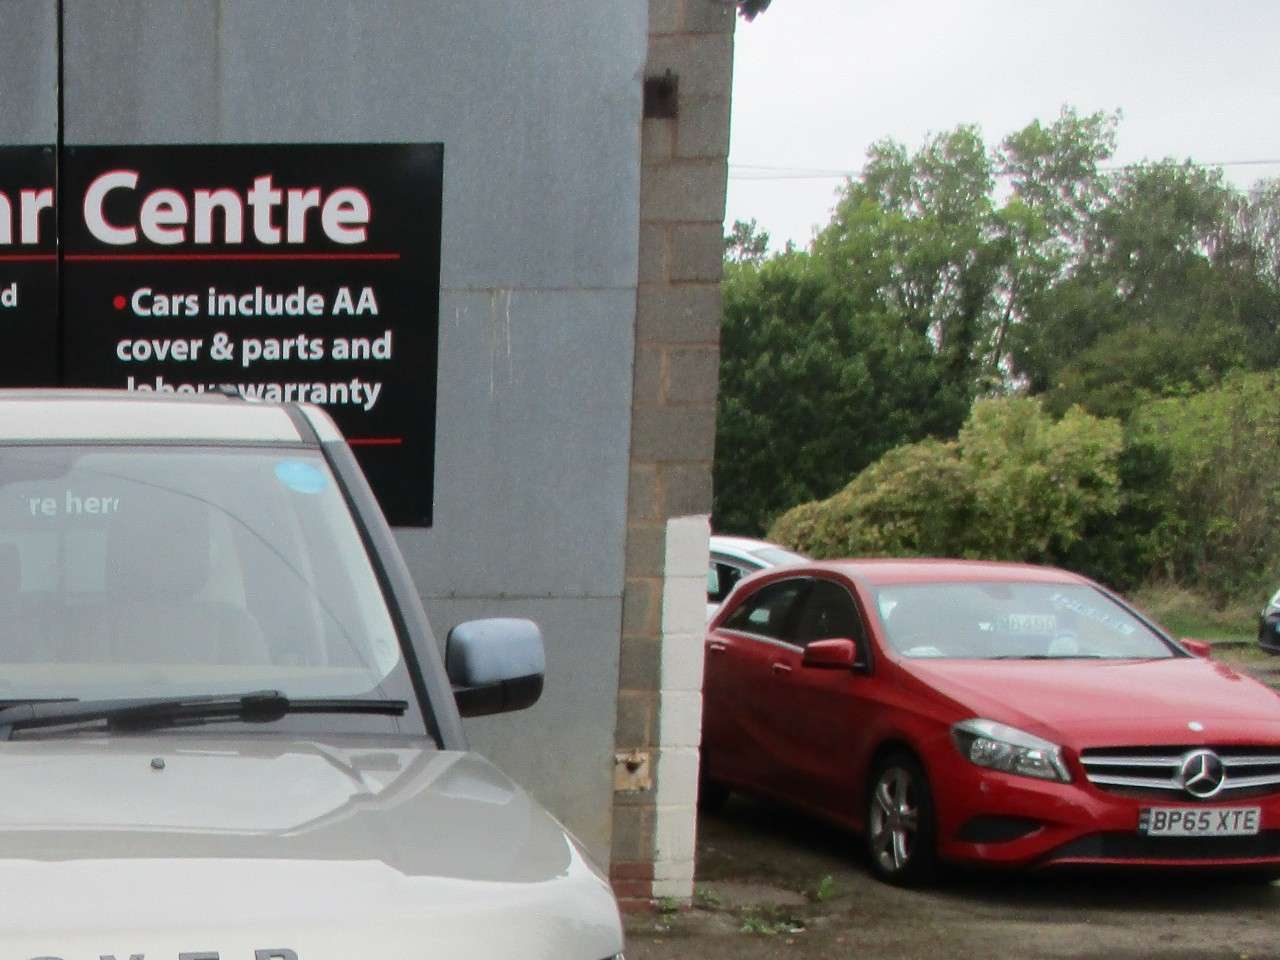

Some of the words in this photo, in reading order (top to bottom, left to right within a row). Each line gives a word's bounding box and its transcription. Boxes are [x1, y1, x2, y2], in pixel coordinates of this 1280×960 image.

[83, 170, 371, 245] Centre
[131, 287, 200, 317] Cars
[208, 285, 325, 316] include
[331, 286, 379, 316] AA
[116, 339, 203, 361] cover
[210, 332, 234, 361] &
[242, 333, 324, 368] parts
[331, 330, 392, 361] and
[238, 378, 382, 411] warranty
[1153, 811, 1212, 831] BP65
[1216, 810, 1256, 831] XTE
